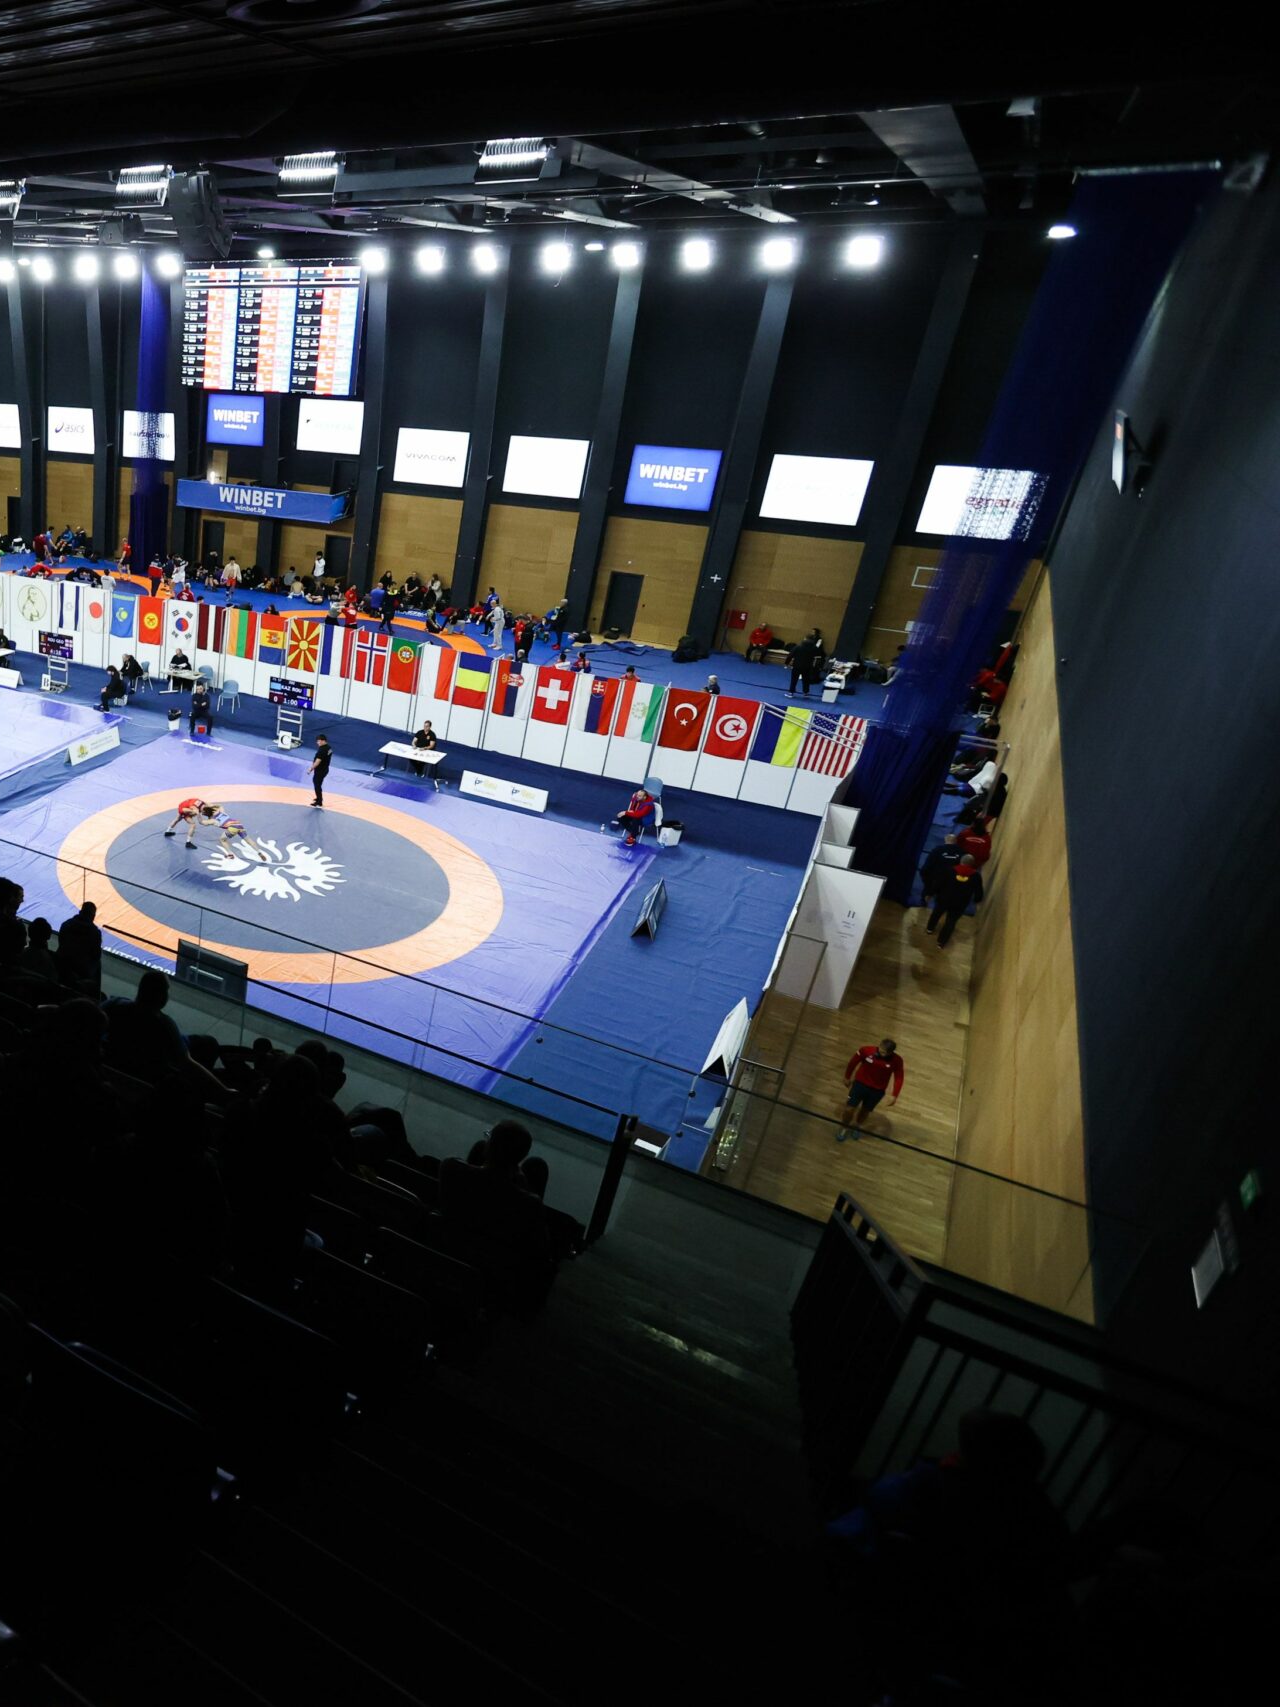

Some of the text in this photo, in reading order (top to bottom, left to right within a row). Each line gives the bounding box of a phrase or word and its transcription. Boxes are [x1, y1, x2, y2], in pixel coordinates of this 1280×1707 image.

[212, 408, 260, 424] WINBET
[64, 424, 86, 434] asics
[404, 452, 457, 463] VIVACOM
[638, 462, 709, 484] WINBET
[652, 480, 689, 492] winbet.bg
[218, 486, 287, 509] WINBET
[234, 503, 267, 515] winbet.bg
[43, 678, 49, 687] B
[283, 697, 298, 706] 1:00
[281, 734, 290, 746] C
